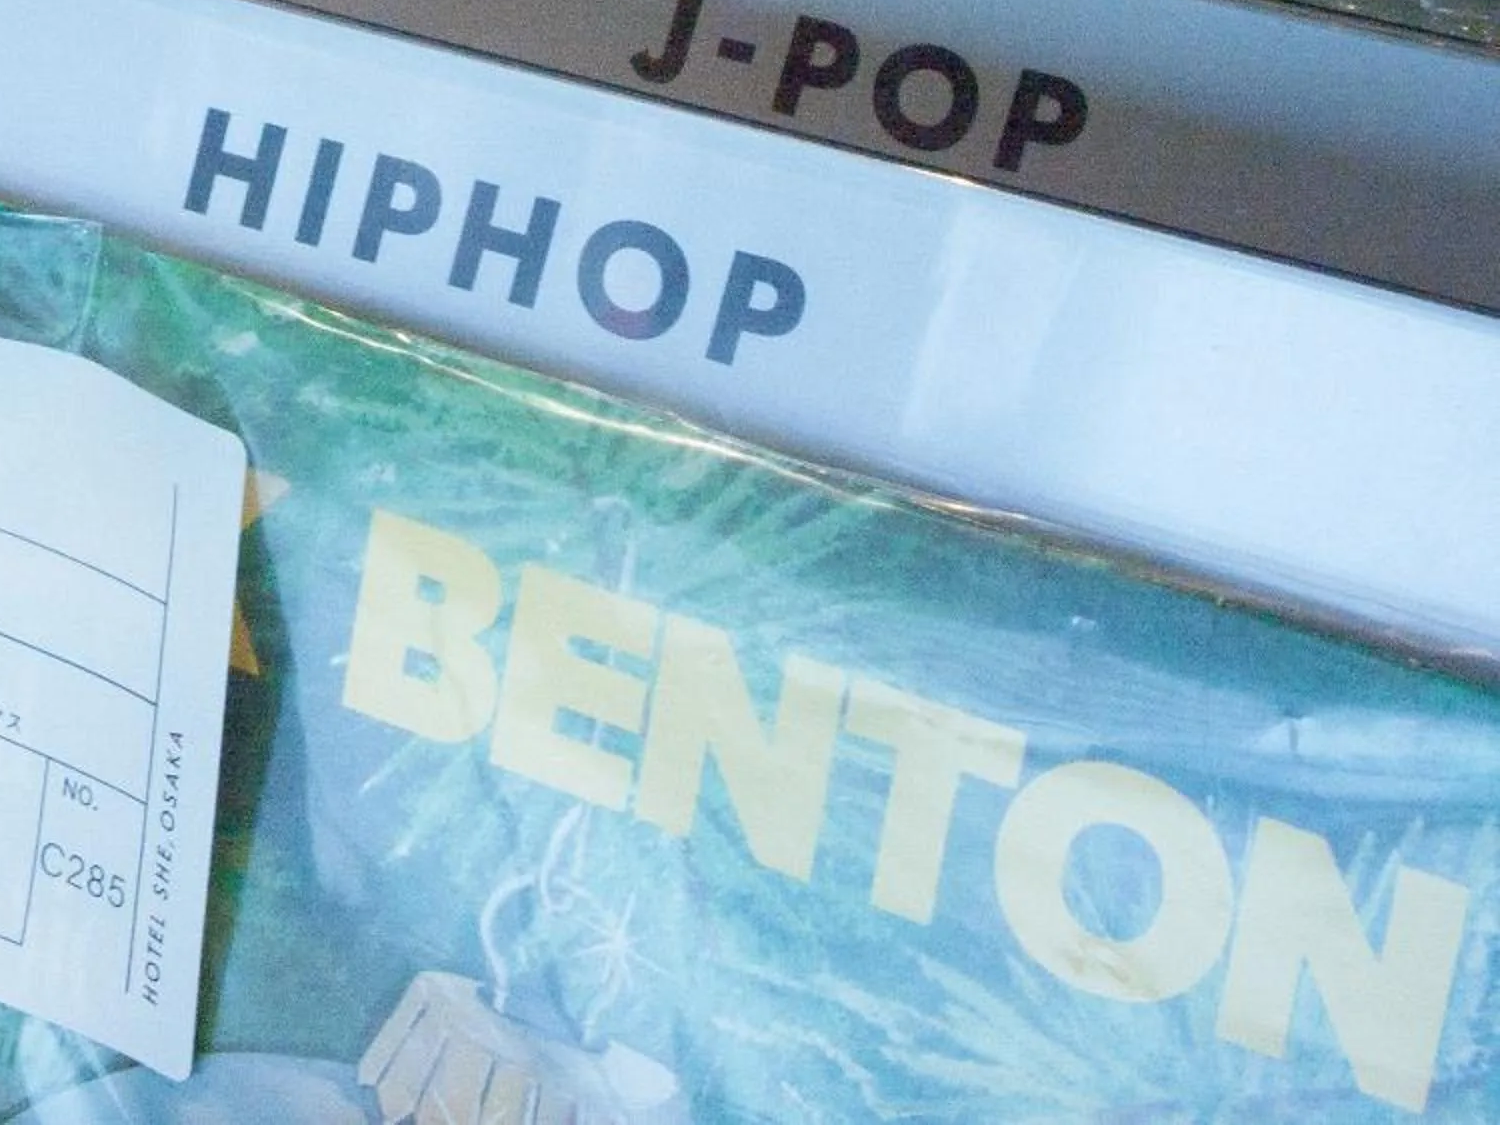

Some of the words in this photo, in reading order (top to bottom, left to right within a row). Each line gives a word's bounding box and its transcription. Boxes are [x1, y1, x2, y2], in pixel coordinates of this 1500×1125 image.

[183, 107, 806, 367] HIPHOP
[62, 777, 98, 811] NO.
[341, 509, 1469, 1115] BENTON
[40, 842, 127, 908] C285
[141, 915, 166, 1007] HOTEL
